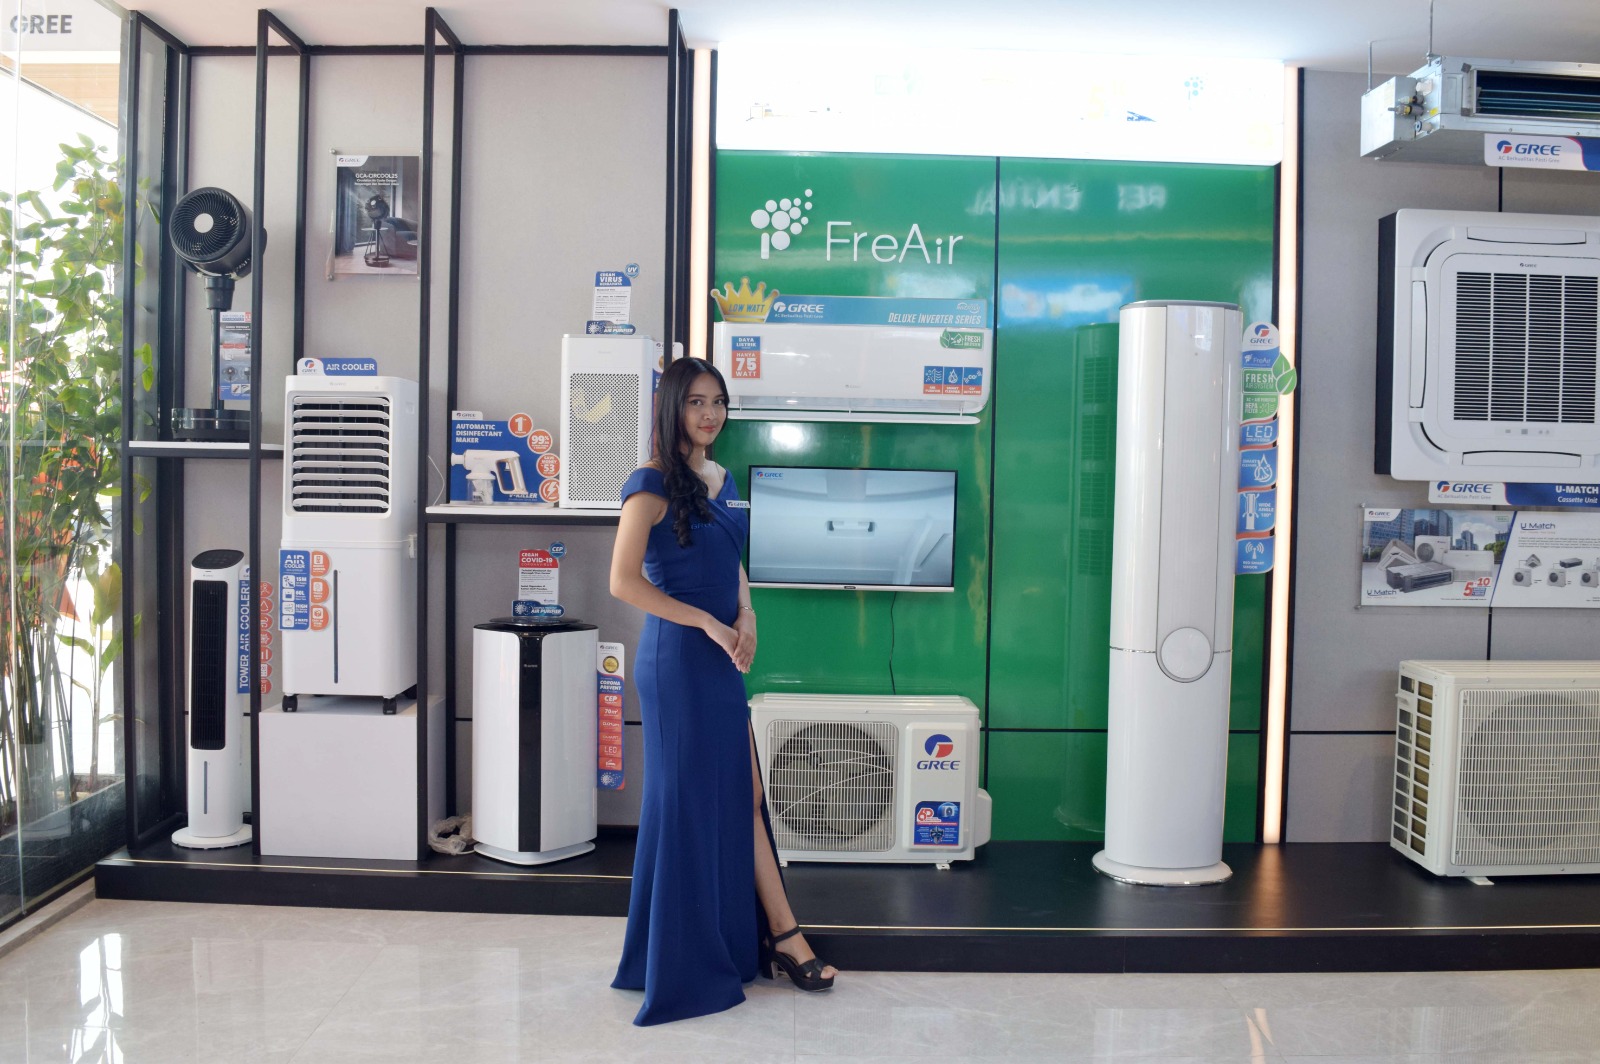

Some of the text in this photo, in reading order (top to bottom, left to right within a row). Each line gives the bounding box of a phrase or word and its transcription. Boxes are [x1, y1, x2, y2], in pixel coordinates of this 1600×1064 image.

[10, 14, 72, 34] GREE
[1515, 144, 1562, 156] GREE
[826, 220, 964, 264] FreAir
[728, 304, 765, 312] LOW WATT
[788, 304, 824, 313] GREE
[888, 313, 981, 324] DELUXE INVERTER SERIES
[736, 358, 756, 370] 75
[1246, 374, 1274, 382] FRESH
[1246, 426, 1273, 437] LED
[1452, 483, 1599, 494] GREE U-MATCH
[284, 555, 305, 564] AIR
[1477, 578, 1490, 587] 10
[1463, 582, 1473, 596] 5
[240, 587, 250, 688] TOWER AIR COOLER
[917, 760, 960, 770] GREE
